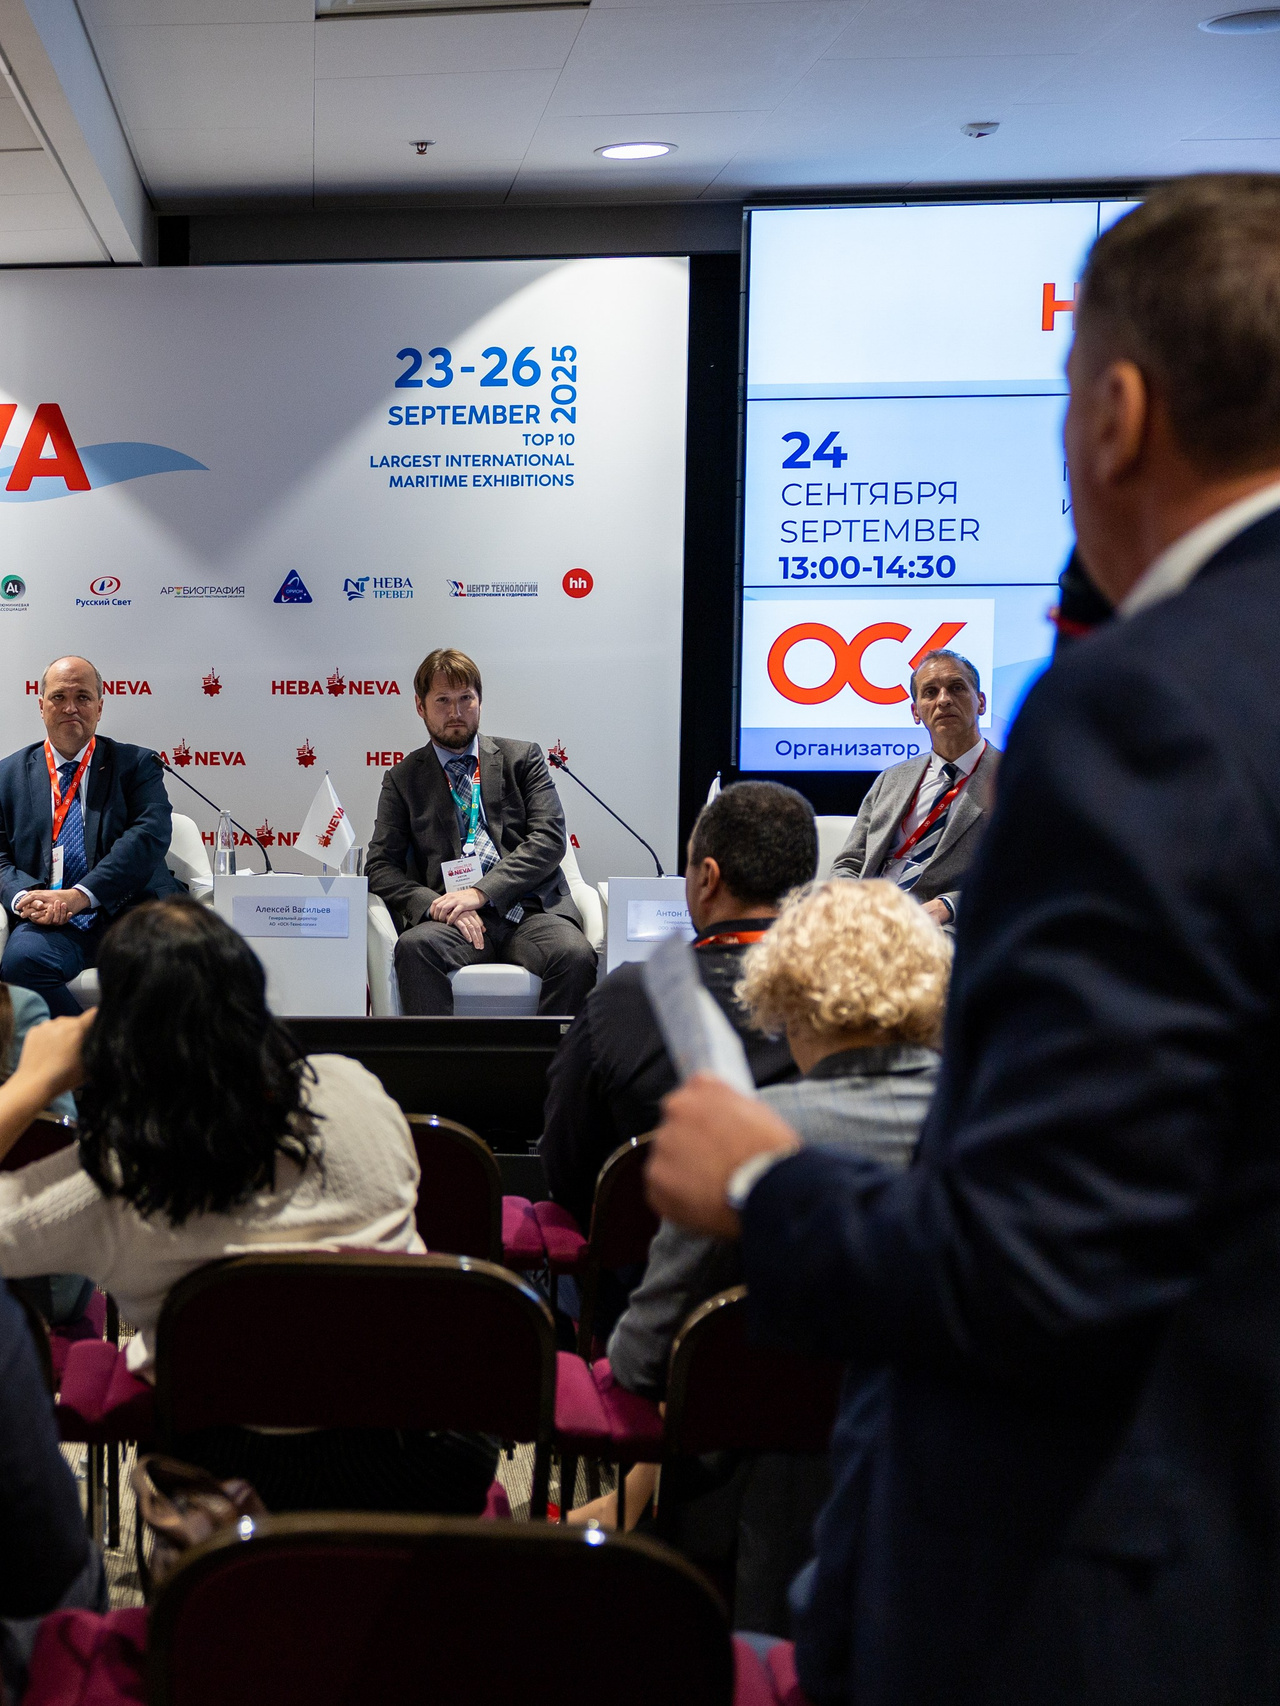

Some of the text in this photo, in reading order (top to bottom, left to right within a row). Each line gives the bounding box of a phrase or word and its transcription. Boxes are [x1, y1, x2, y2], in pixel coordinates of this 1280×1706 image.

[395, 346, 541, 388] 23-26
[551, 345, 577, 424] 2025
[388, 404, 540, 425] SEPTEMBER
[522, 433, 575, 446] TOP 10
[781, 431, 848, 469] 24
[370, 453, 575, 468] LARGEST INTERNATIONAL
[389, 474, 575, 488] MARITIME EXHIBITIONS
[781, 481, 959, 507] СЕНТЯБРЯ
[780, 518, 980, 544] SEPTEMBER
[778, 555, 956, 580] 13:00-14:30
[373, 577, 414, 589] НЕВА
[466, 584, 538, 593] ЦЕНТР ТЕХНОЛОГИИ
[569, 577, 587, 589] hh
[373, 590, 414, 598] ТРЕВЕЛ
[75, 598, 131, 607] Русский Свет
[102, 681, 152, 694] NEVA
[271, 680, 323, 695] НЕВА
[349, 681, 401, 695] NEVA
[195, 751, 246, 765] NEVA
[366, 751, 404, 766] НЕВ
[775, 740, 920, 763] Организатор
[325, 807, 345, 836] NEVA
[202, 831, 253, 846] НВА
[256, 905, 290, 913] Алексей
[656, 909, 682, 917] Антон
